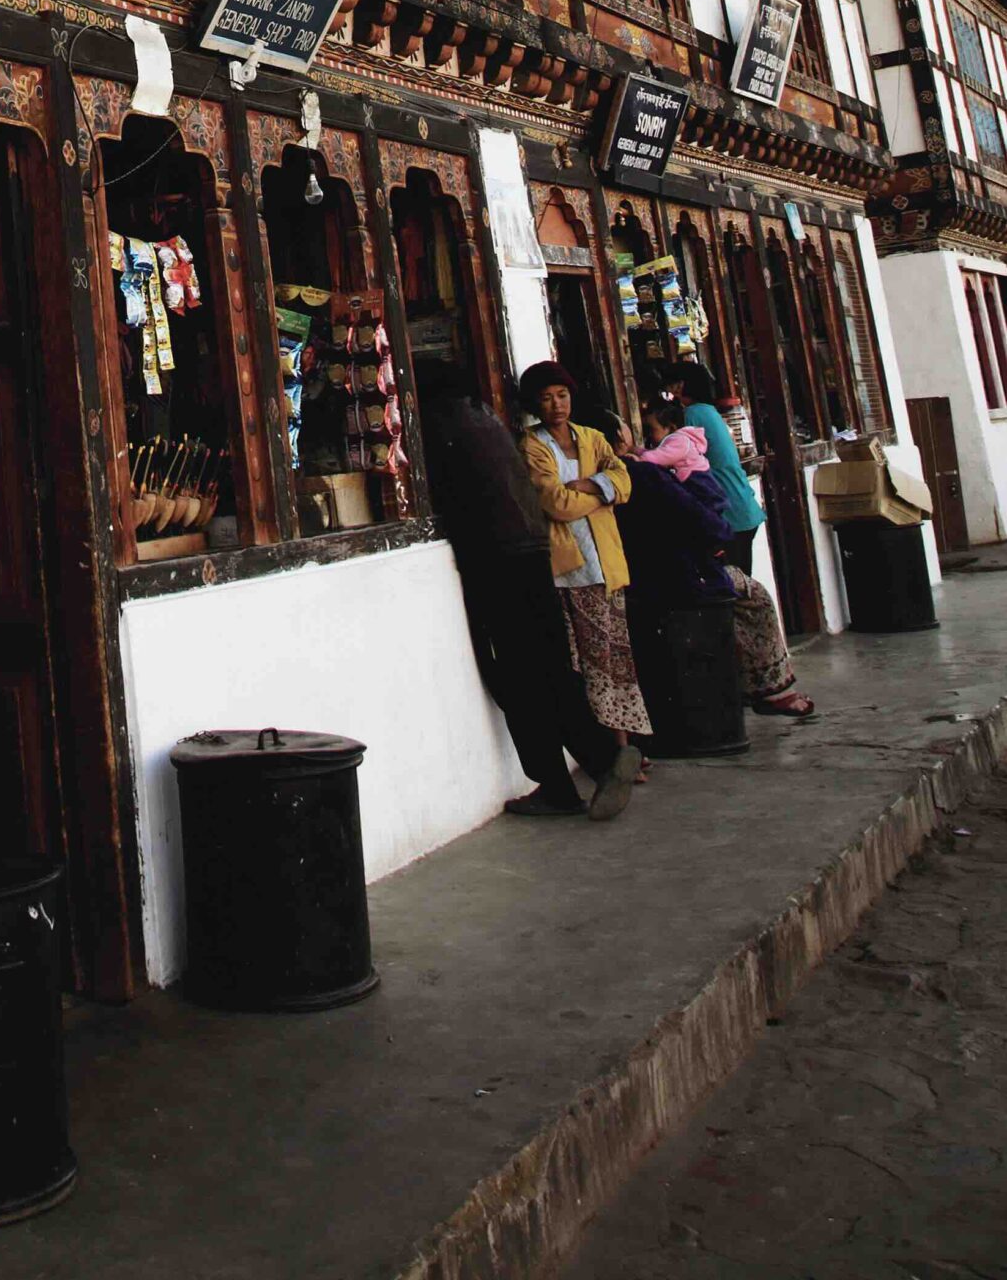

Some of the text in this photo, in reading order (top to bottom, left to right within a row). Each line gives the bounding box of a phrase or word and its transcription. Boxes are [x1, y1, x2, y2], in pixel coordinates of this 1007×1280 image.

[216, 8, 262, 38] GENERAL
[292, 29, 317, 52] PARO
[635, 112, 667, 139] SONAM
